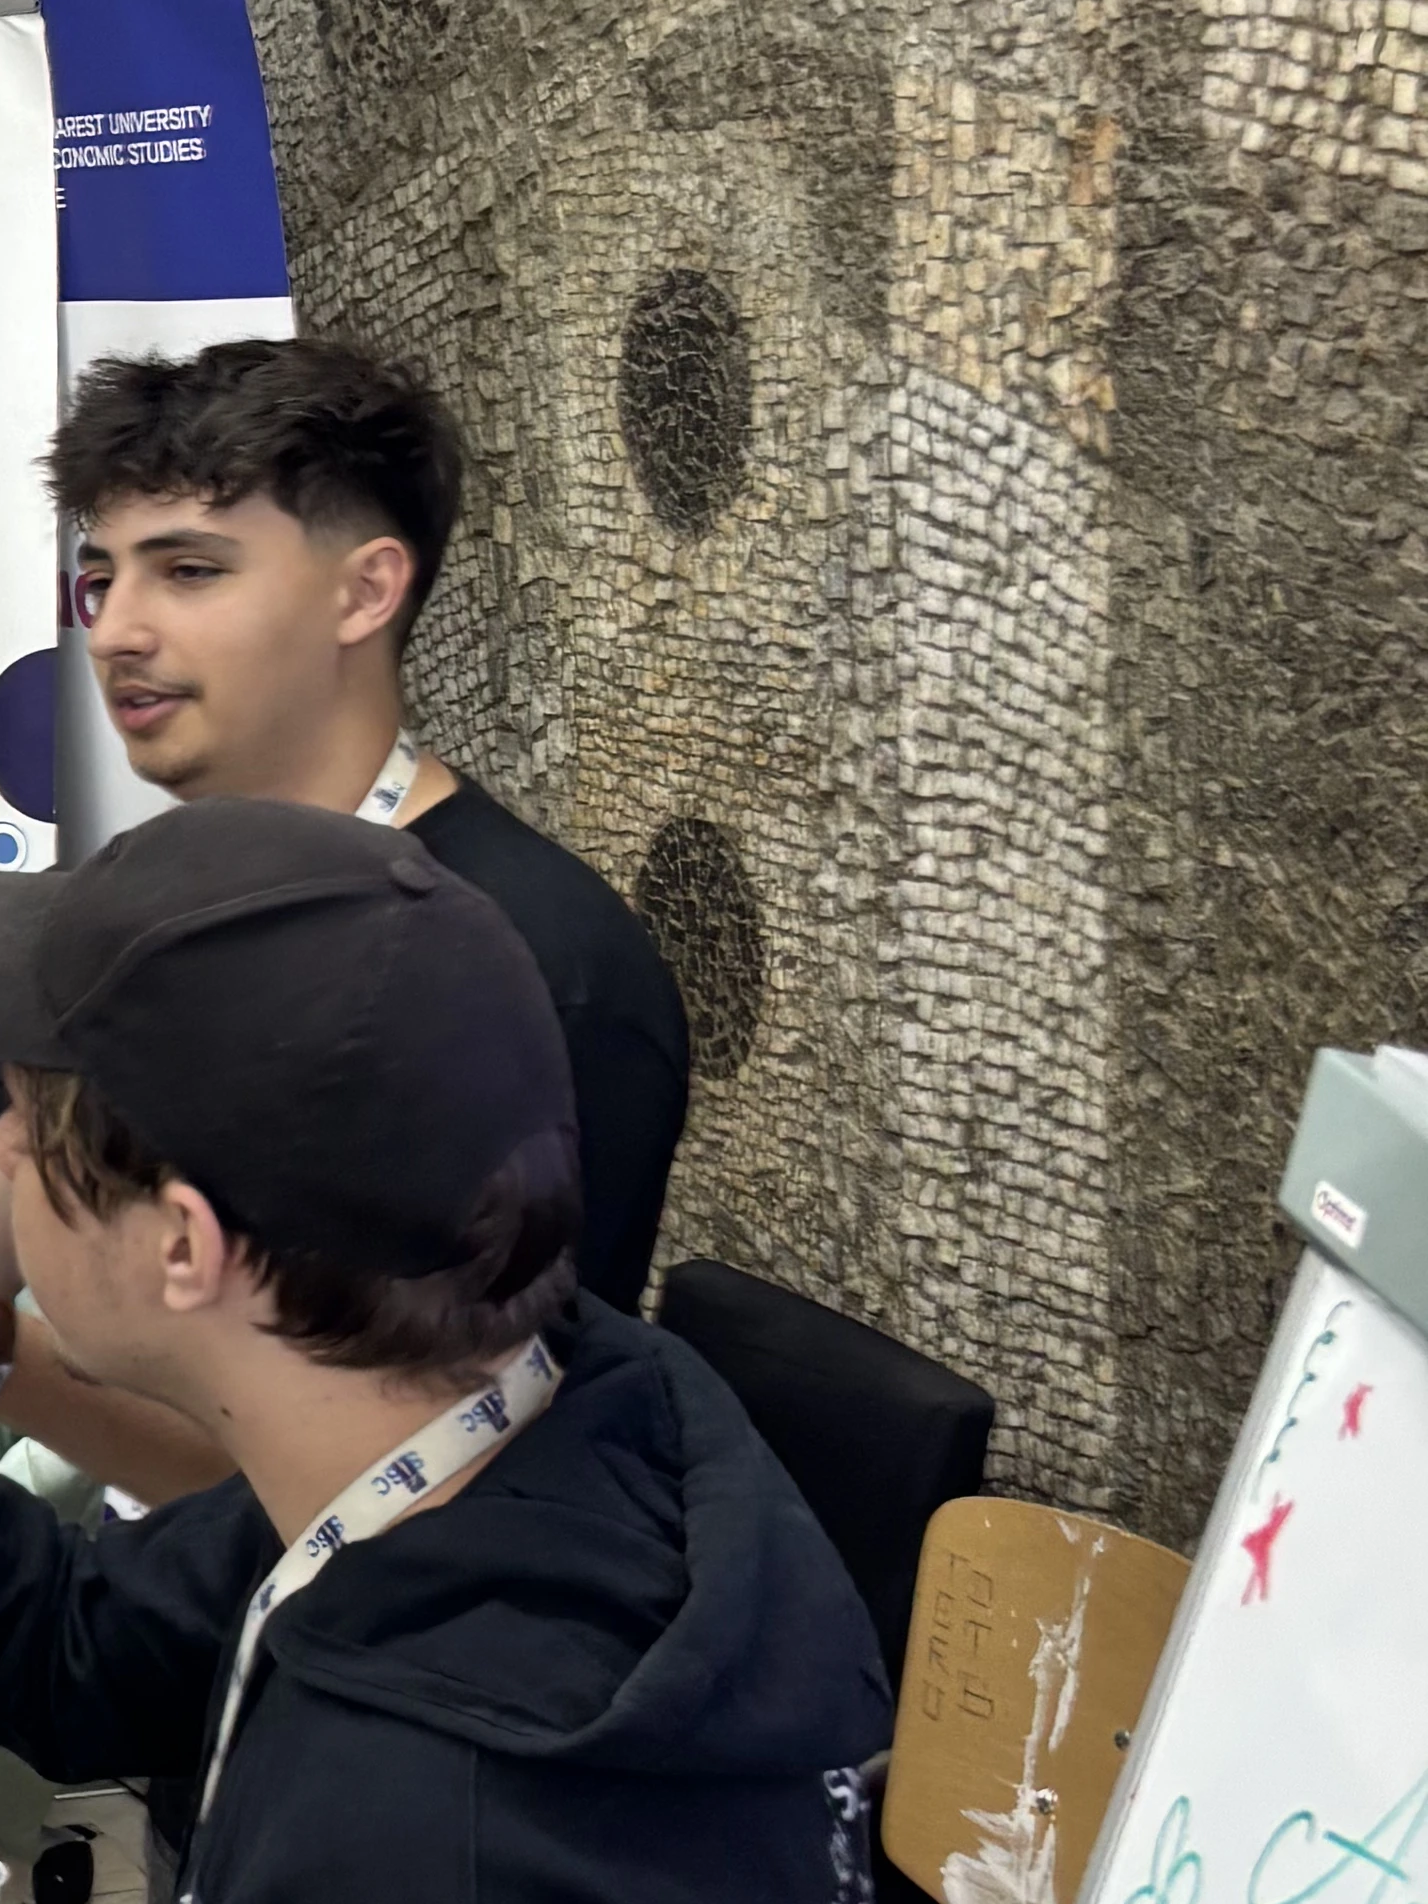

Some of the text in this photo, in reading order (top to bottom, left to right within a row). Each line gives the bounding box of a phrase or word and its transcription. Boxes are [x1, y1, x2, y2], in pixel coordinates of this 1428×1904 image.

[54, 104, 212, 139] AREST UNIVERSITY
[52, 137, 207, 170] CONOMIC STUDIES
